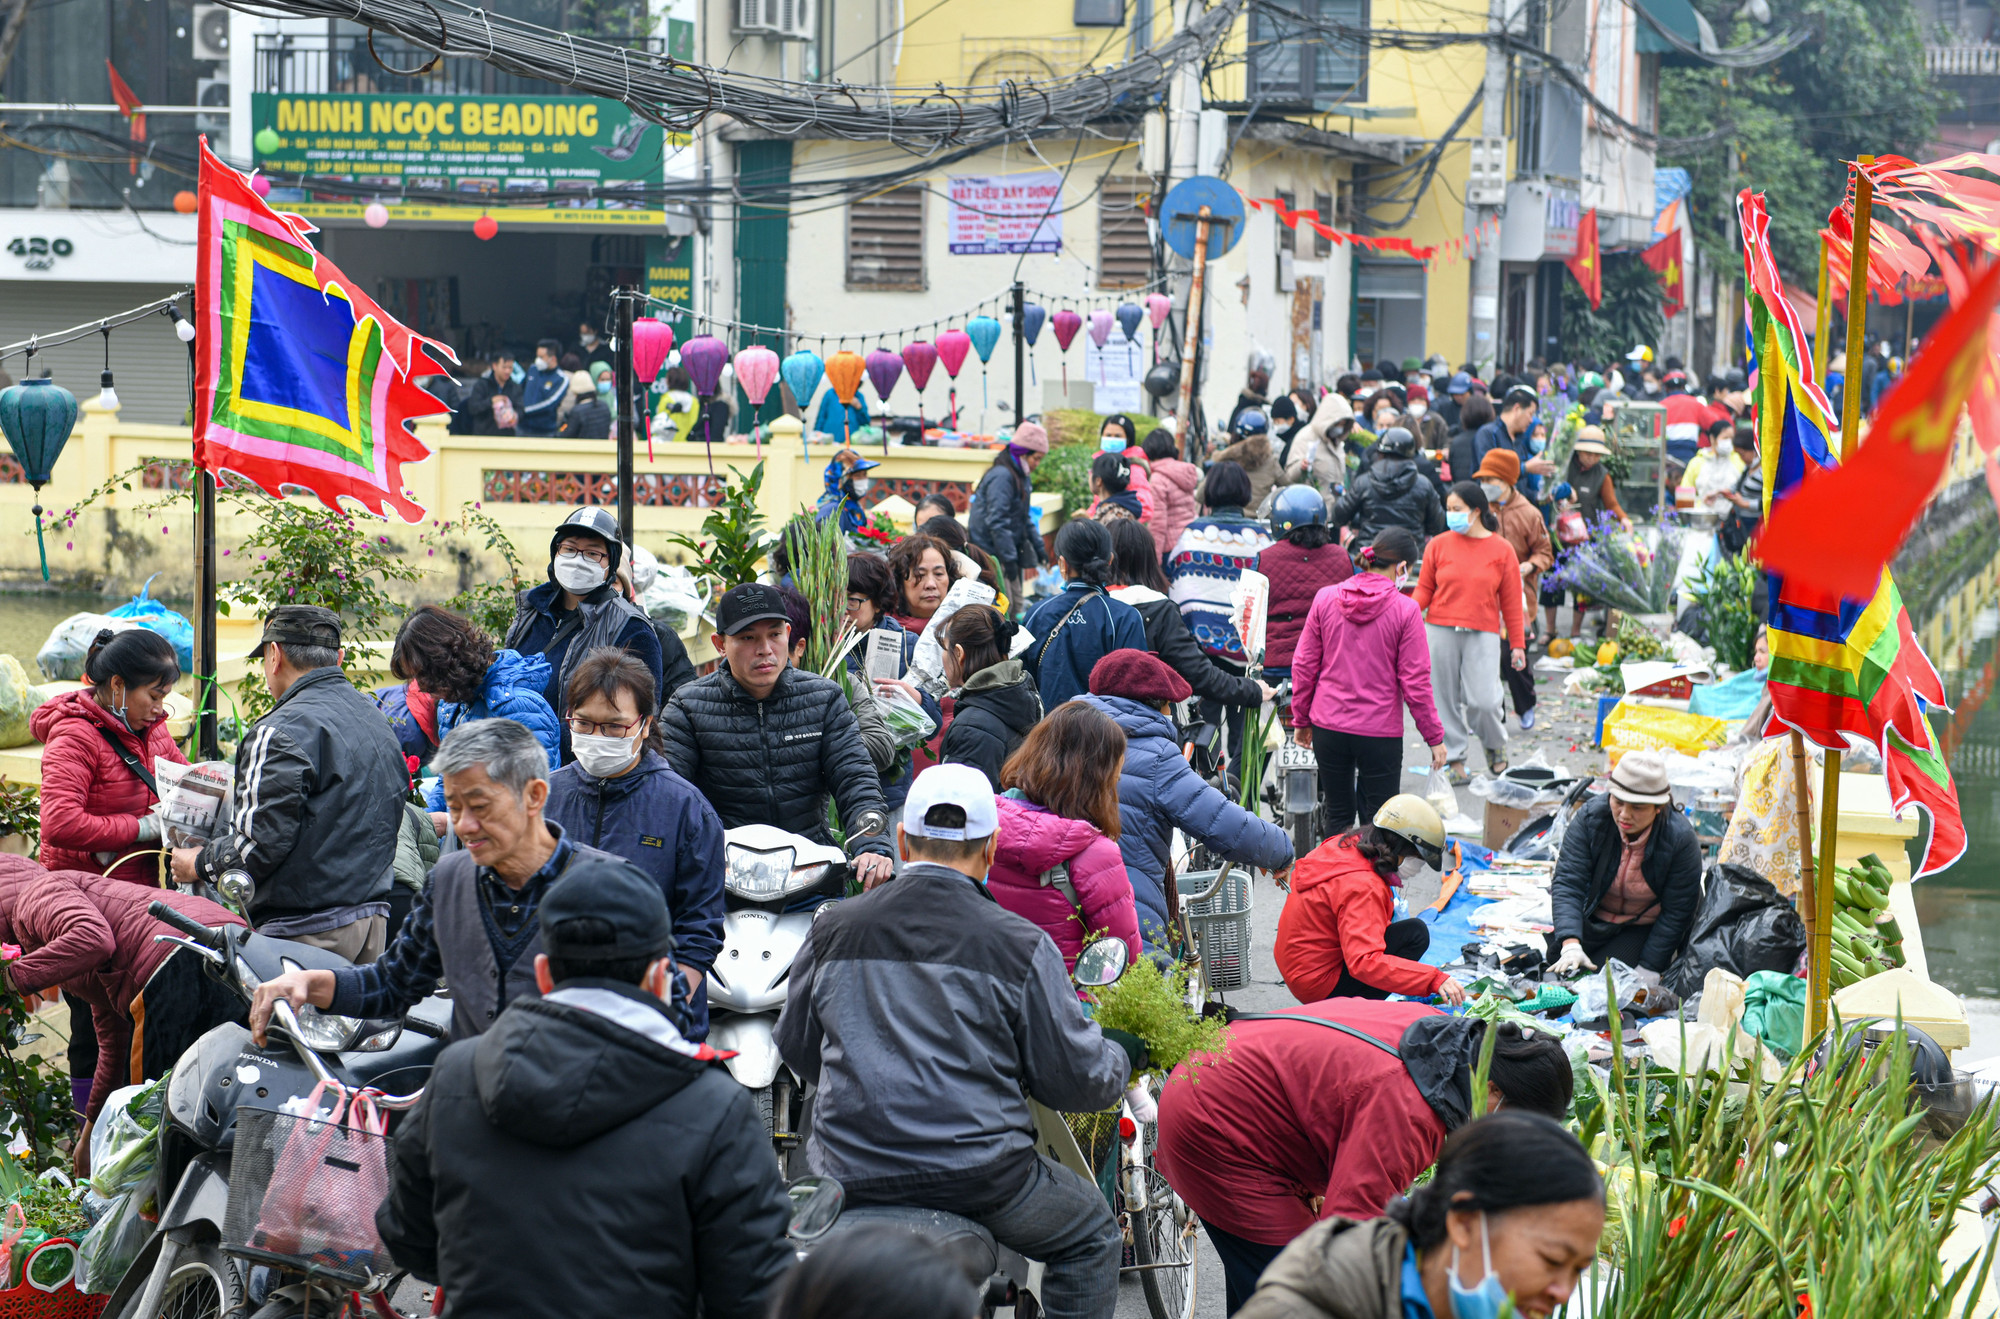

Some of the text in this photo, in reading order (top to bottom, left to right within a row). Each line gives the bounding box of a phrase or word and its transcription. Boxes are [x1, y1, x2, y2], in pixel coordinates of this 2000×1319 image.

[277, 99, 599, 141] MINH NGỌC BEADING
[7, 237, 73, 256] 420
[649, 266, 690, 280] MINH
[650, 285, 690, 303] NGỌC
[741, 602, 769, 613] adidas
[738, 913, 768, 921] HONDA
[238, 1052, 279, 1069] HONDA
